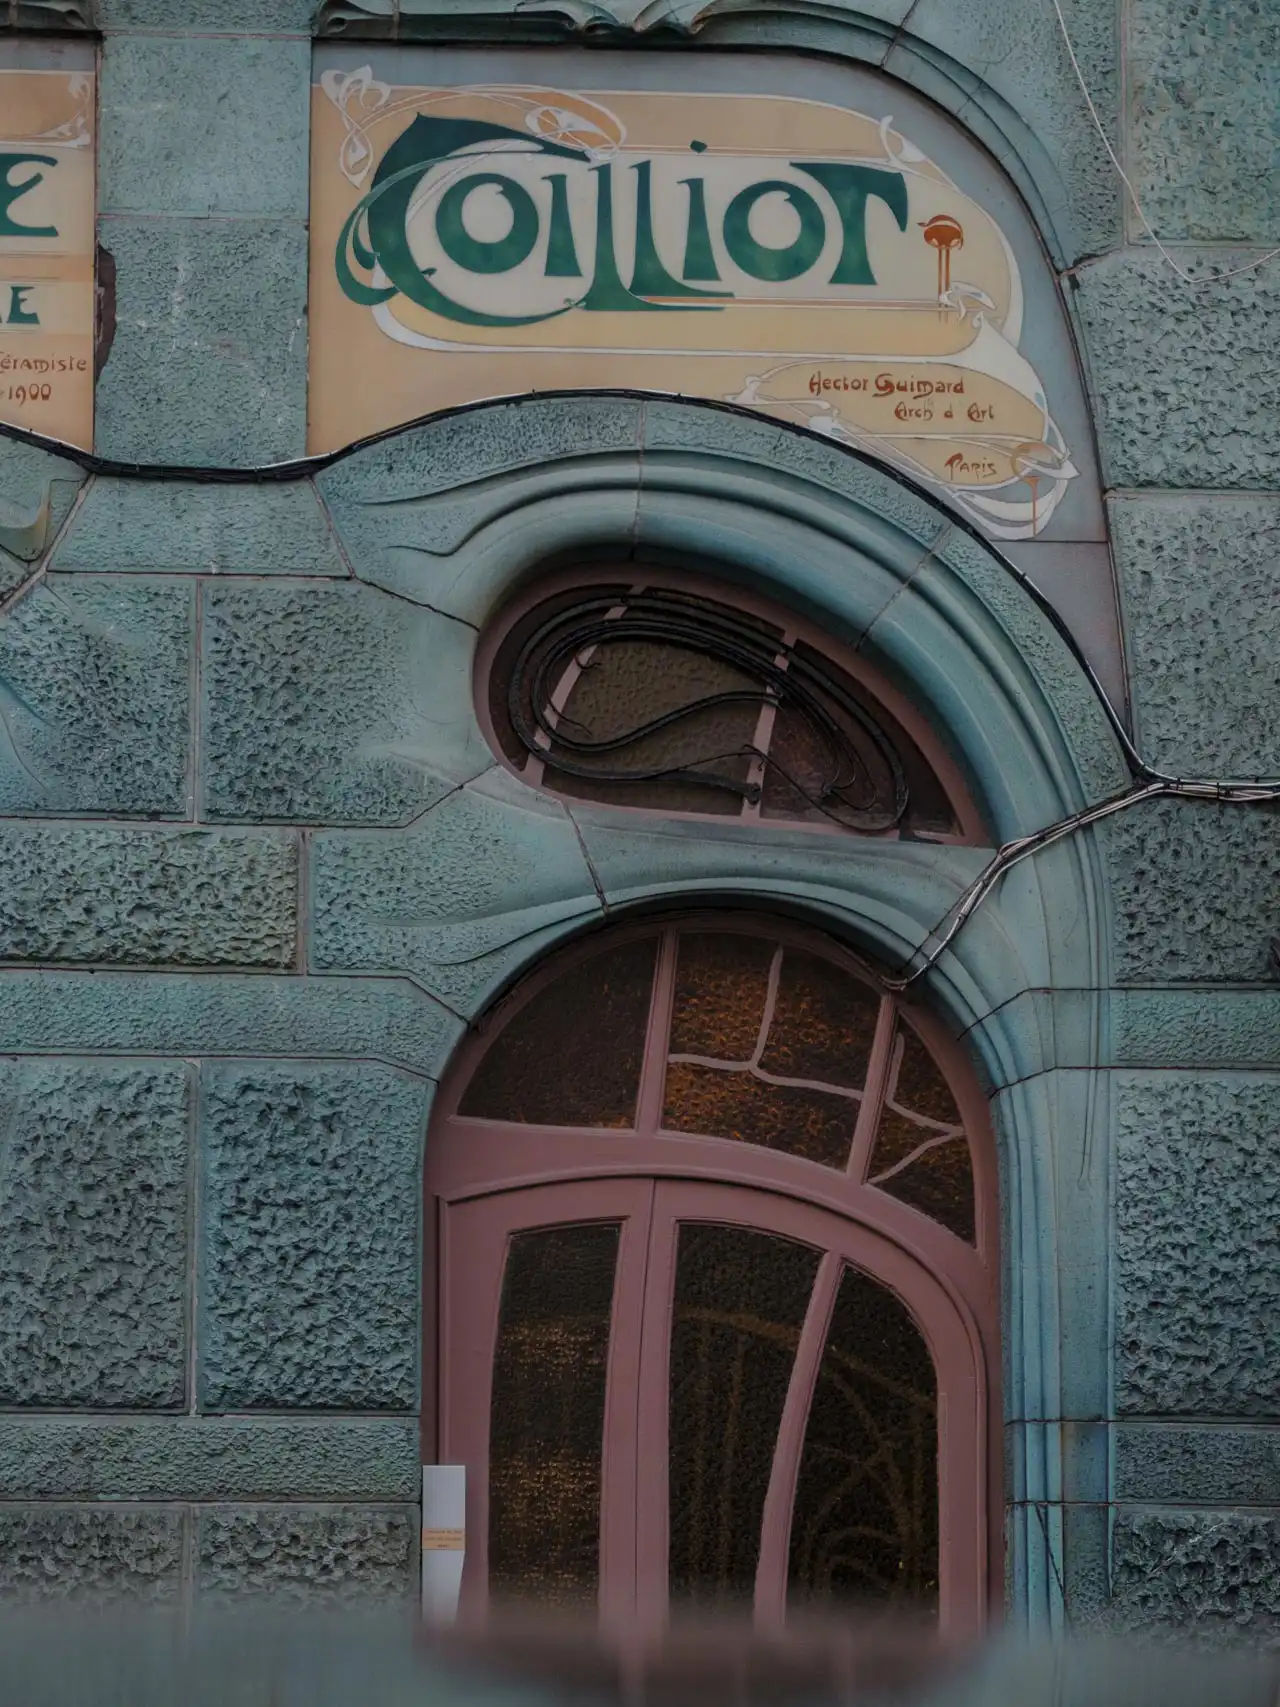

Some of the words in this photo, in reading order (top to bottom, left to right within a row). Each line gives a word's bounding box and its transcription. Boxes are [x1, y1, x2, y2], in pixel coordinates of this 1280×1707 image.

[8, 383, 51, 406] 1900
[809, 371, 868, 396] Hector
[872, 373, 964, 399] Guimard
[967, 402, 995, 423] Art
